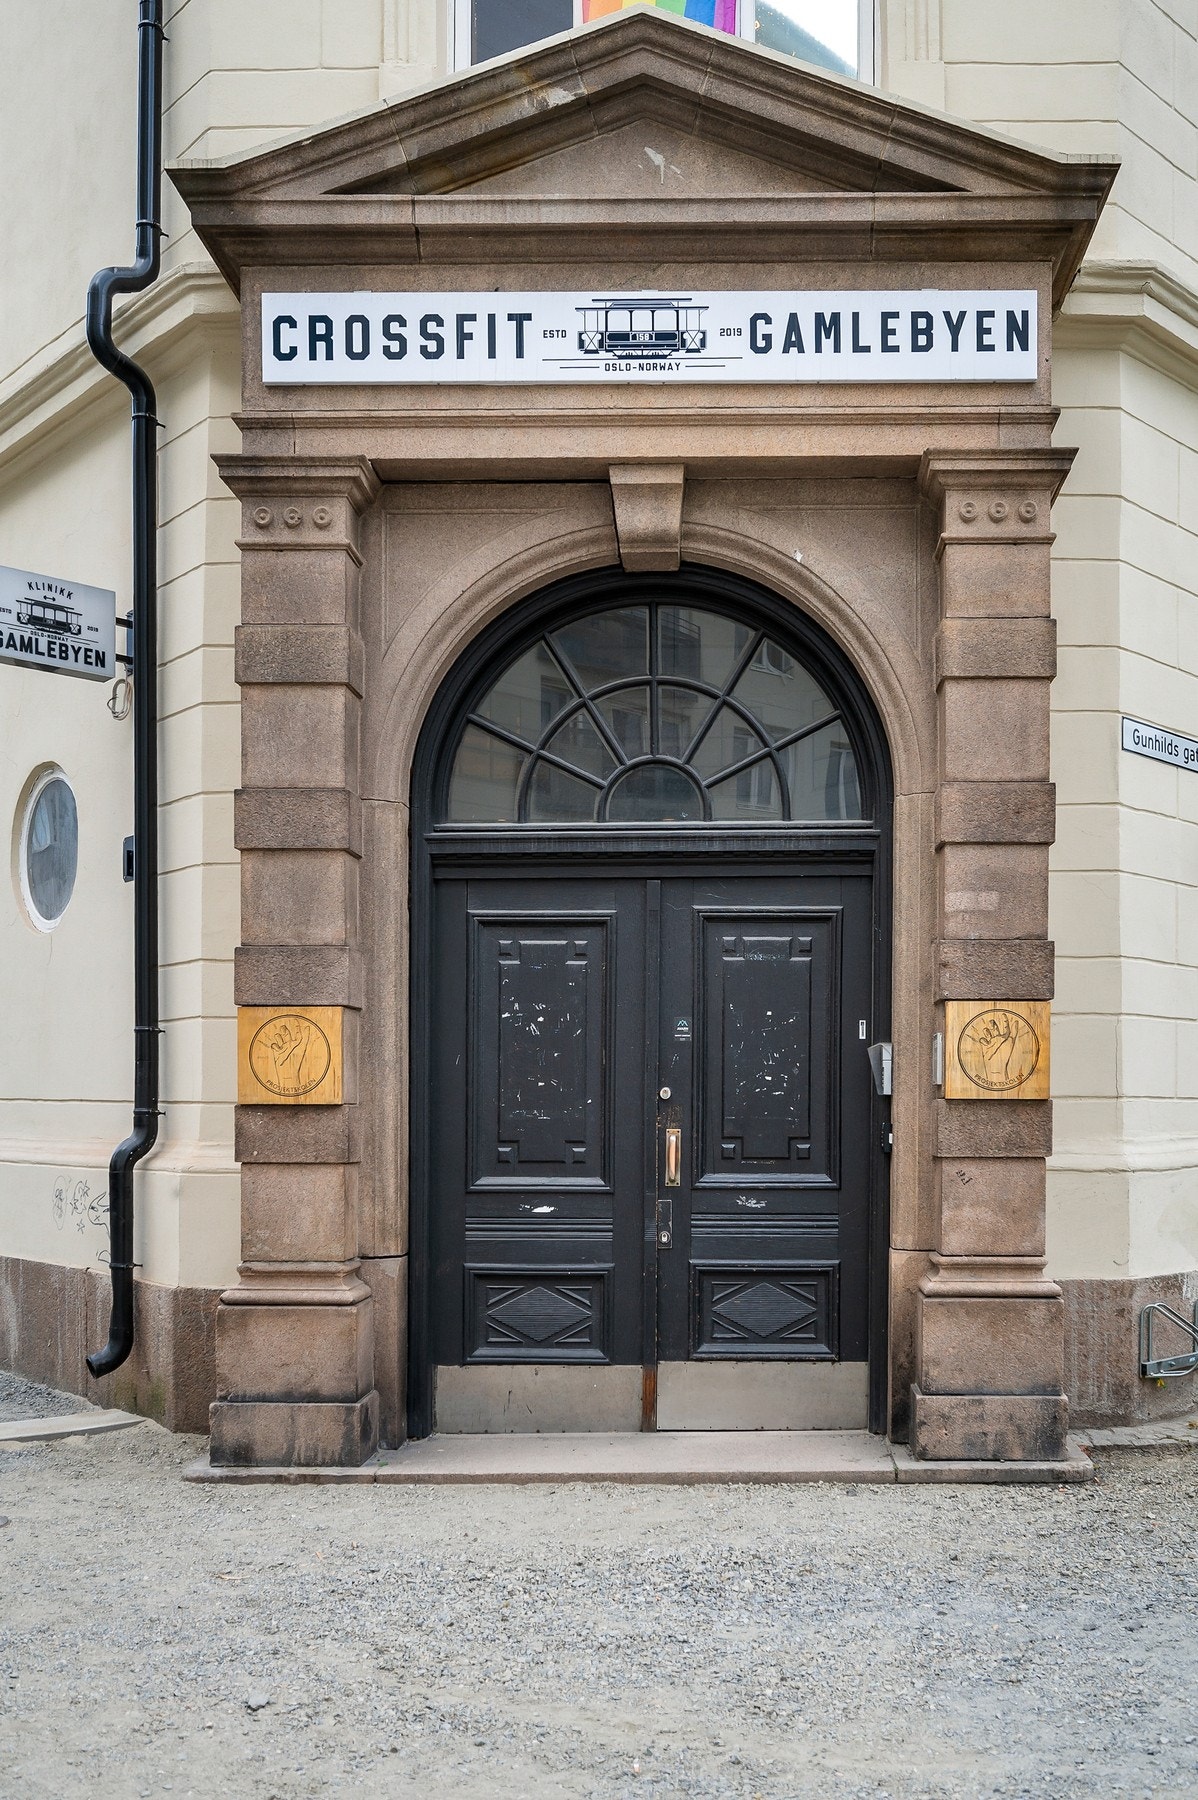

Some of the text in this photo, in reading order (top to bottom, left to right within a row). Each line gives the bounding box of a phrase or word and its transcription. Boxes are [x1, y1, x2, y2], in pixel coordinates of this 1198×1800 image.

[272, 310, 1030, 361] CROSSFIT GAMLEBYEN
[543, 328, 743, 339] ESTD 2019
[604, 362, 681, 372] OSLO-NORWAY
[27, 581, 74, 600] KLINIKK
[1132, 728, 1179, 757] Gunhilds
[265, 1078, 317, 1093] PROSJEKTSKOLEN
[974, 1072, 1025, 1087] PROSJEKTSKOLEN
